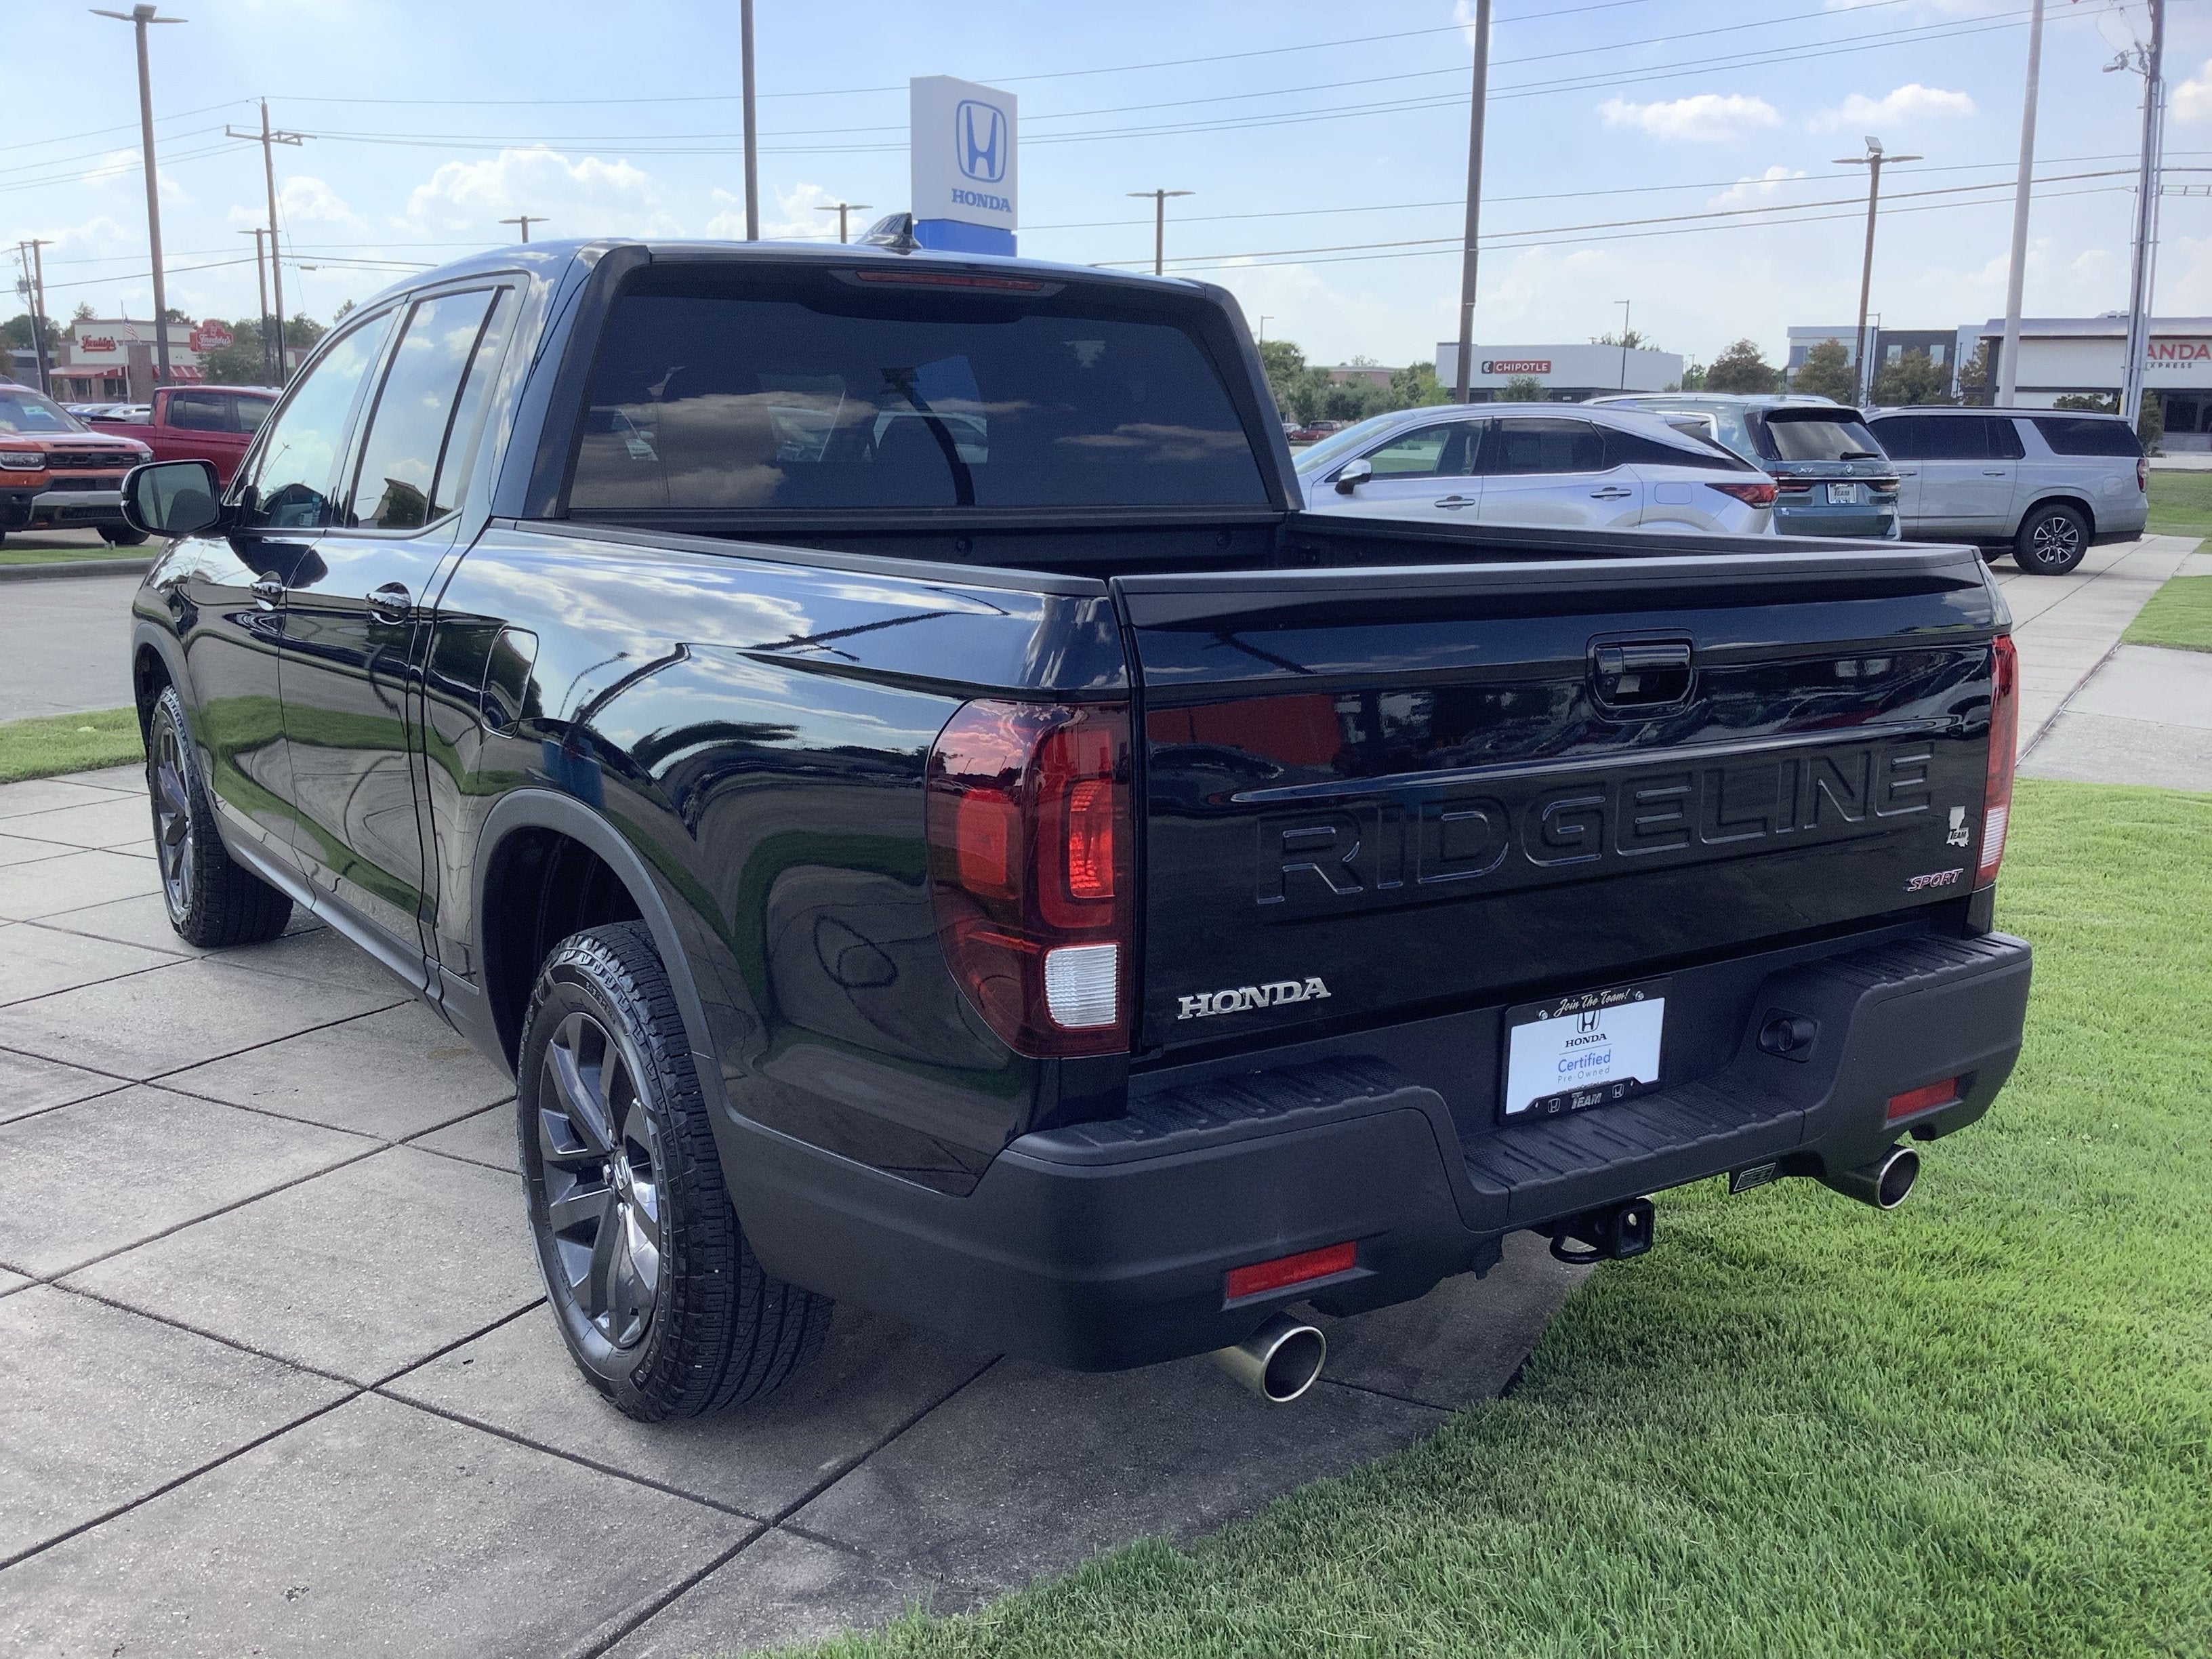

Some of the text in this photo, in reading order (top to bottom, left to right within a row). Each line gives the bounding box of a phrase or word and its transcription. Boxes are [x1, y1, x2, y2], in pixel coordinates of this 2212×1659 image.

[951, 188, 1012, 213] HONDA
[2147, 344, 2211, 360] ANDA
[1496, 363, 1548, 371] CHIPOTLE
[1256, 742, 1933, 904] RIDGELINE
[1906, 868, 1964, 892] SPORT
[1177, 977, 1331, 1021] HONDA
[1553, 988, 1631, 1018] Join The Team!
[1565, 1033, 1607, 1048] HONDA
[1558, 1049, 1611, 1073] Certified
[1558, 1065, 1610, 1084] Pre-Owned
